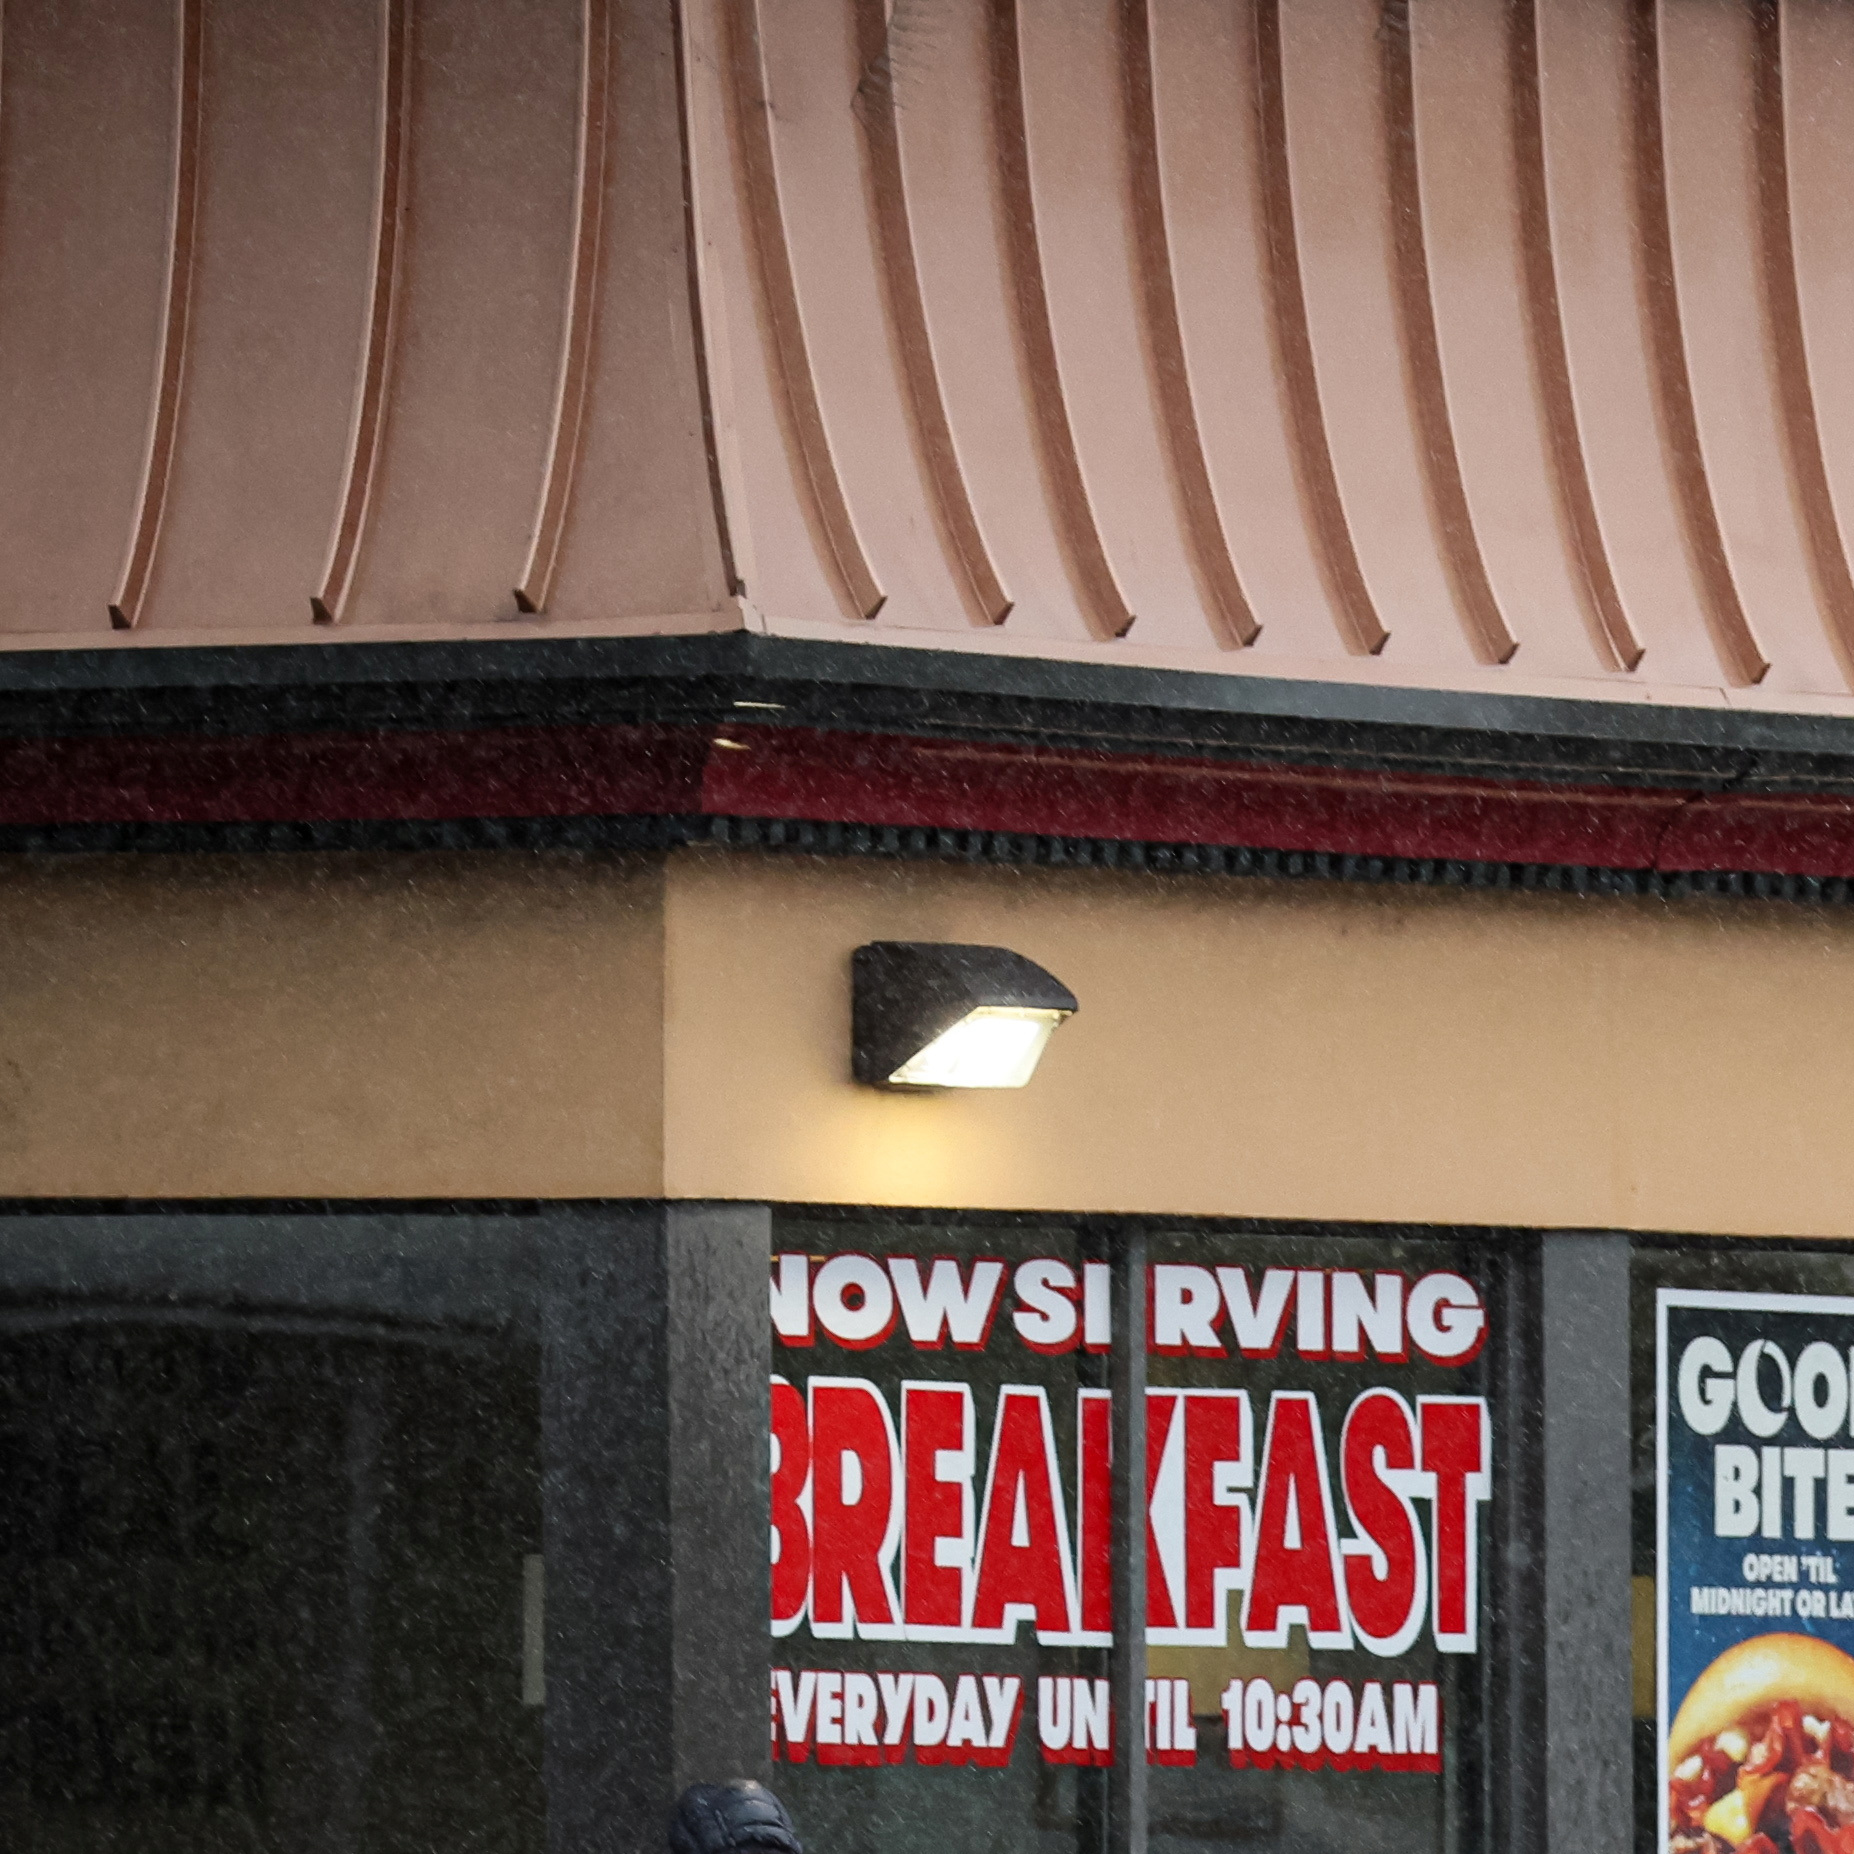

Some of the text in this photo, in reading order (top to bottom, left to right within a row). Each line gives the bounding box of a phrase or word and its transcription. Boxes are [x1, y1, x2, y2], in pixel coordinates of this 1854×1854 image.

[770, 1252, 1005, 1351] NOW
[1742, 1553, 1798, 1583] OPEN
[1690, 1586, 1795, 1617] MIDNIGHT
[1795, 1589, 1827, 1619] OR
[770, 1668, 1024, 1768] VERYDAY
[1220, 1678, 1444, 1773] 10:30AM
